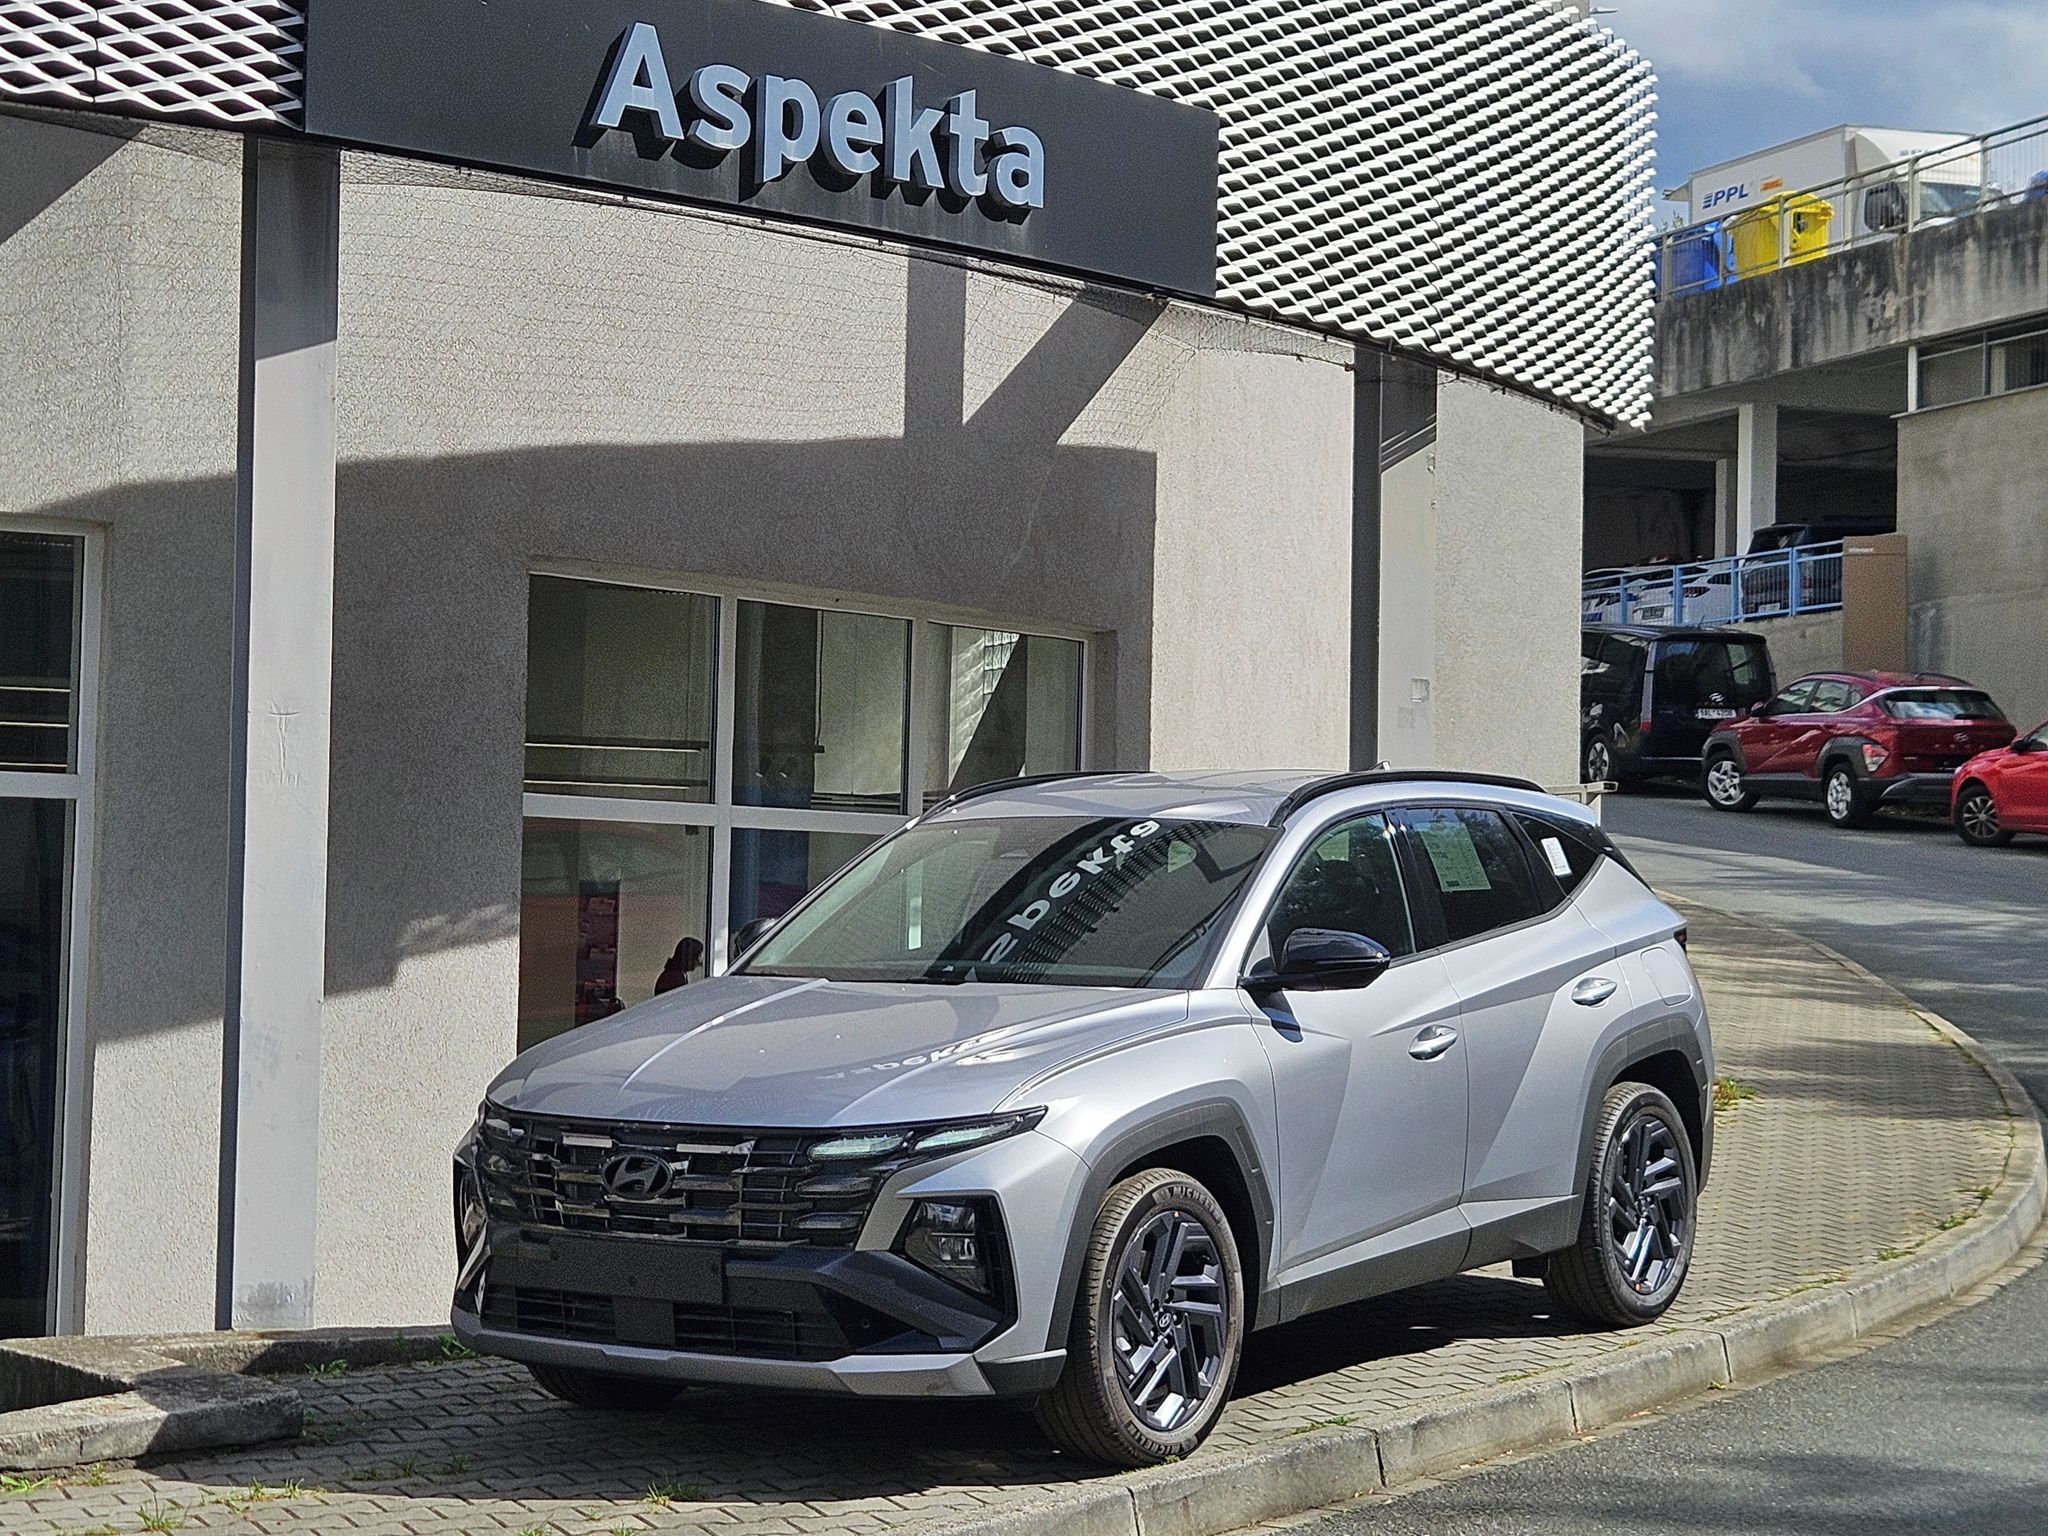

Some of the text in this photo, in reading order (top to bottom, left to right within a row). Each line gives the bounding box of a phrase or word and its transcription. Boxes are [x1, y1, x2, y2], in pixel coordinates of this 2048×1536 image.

[594, 20, 1046, 209] Aspekta
[1712, 183, 1749, 207] PPL
[1172, 1185, 1221, 1221] MICHELIN
[1127, 1424, 1181, 1456] MICHELIN
